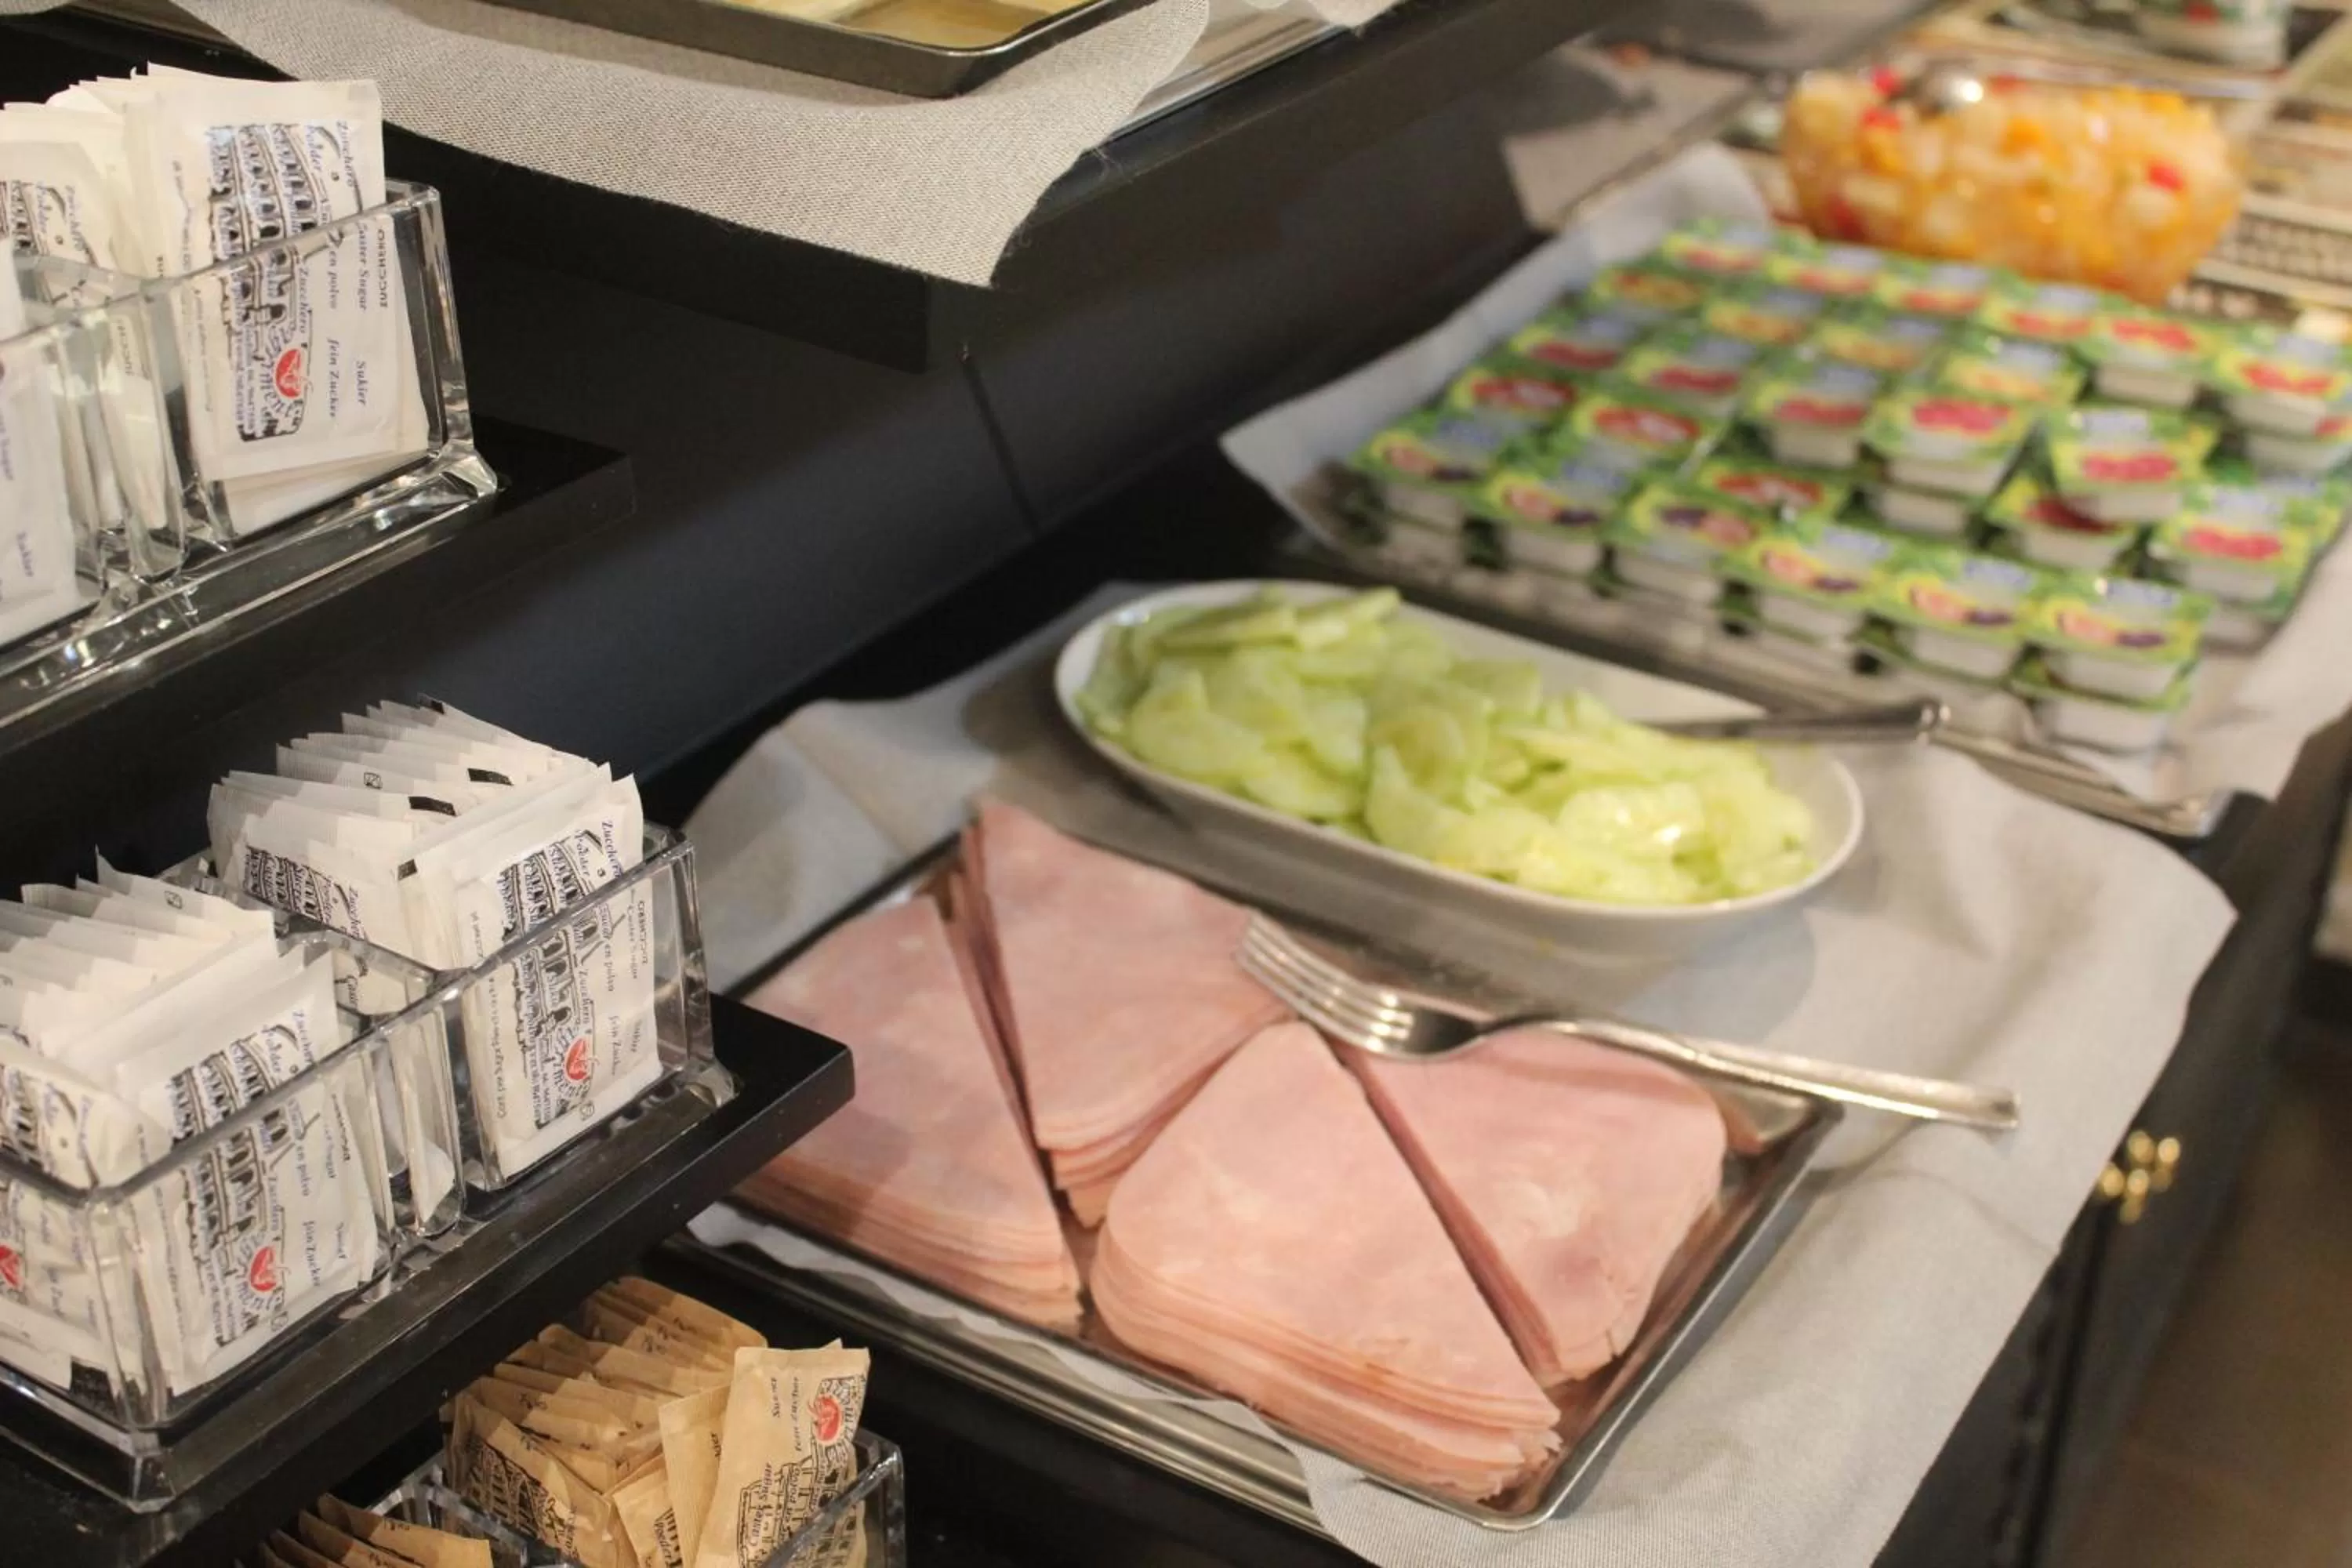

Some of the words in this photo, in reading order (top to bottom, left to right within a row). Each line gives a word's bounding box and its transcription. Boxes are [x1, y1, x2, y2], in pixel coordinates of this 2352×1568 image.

[329, 250, 338, 267] en
[298, 267, 310, 335] Zucchero
[327, 271, 341, 310] polvo
[356, 269, 371, 311] Sugar
[327, 338, 341, 367] fein
[355, 360, 369, 407] Sukier
[349, 887, 363, 938] Zuccher
[293, 1011, 315, 1064] Zuccher
[750, 1504, 764, 1547] Caster
[757, 1461, 774, 1501] Sugar
[786, 1466, 801, 1504] polvo
